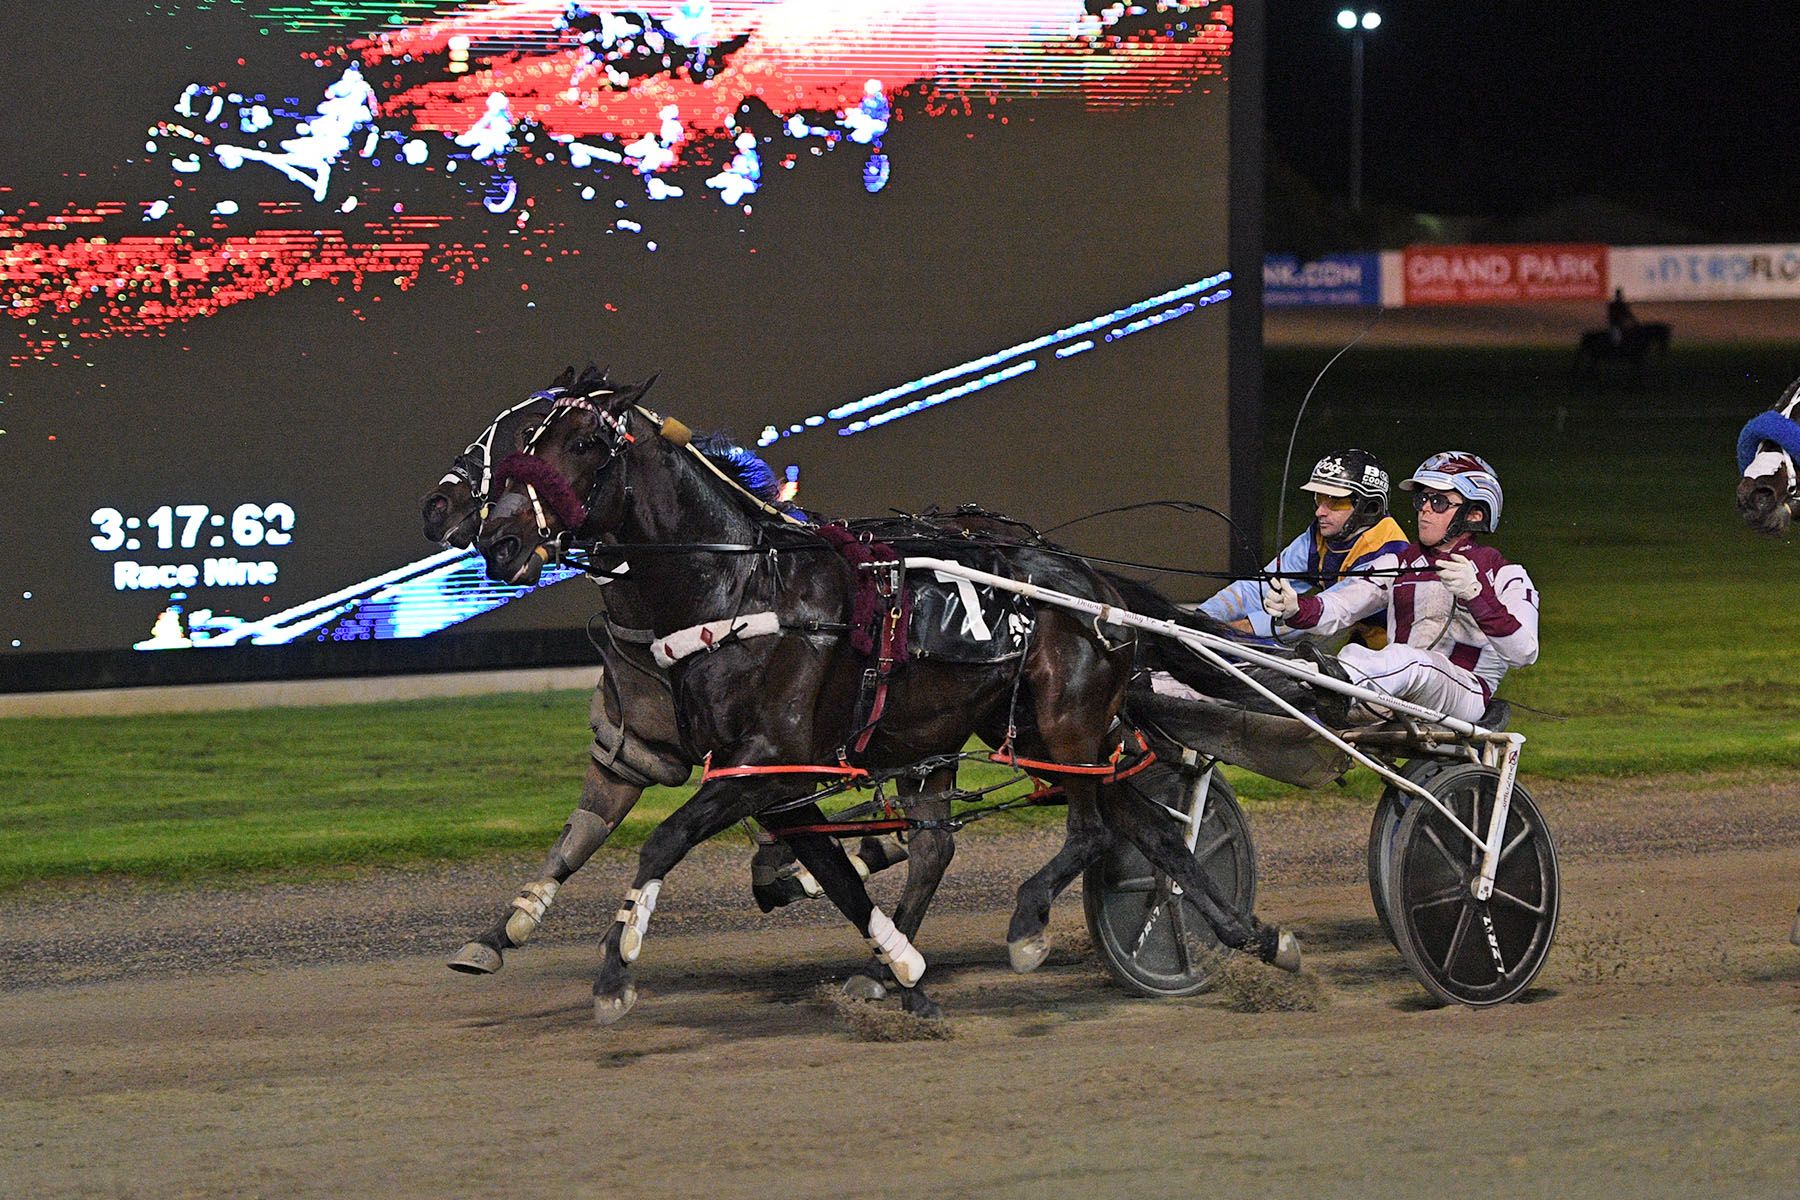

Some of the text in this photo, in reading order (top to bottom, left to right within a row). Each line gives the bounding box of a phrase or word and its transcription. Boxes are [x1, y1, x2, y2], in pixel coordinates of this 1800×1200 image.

[1408, 253, 1600, 283] GRAND PARK
[114, 558, 279, 590] Race Nine
